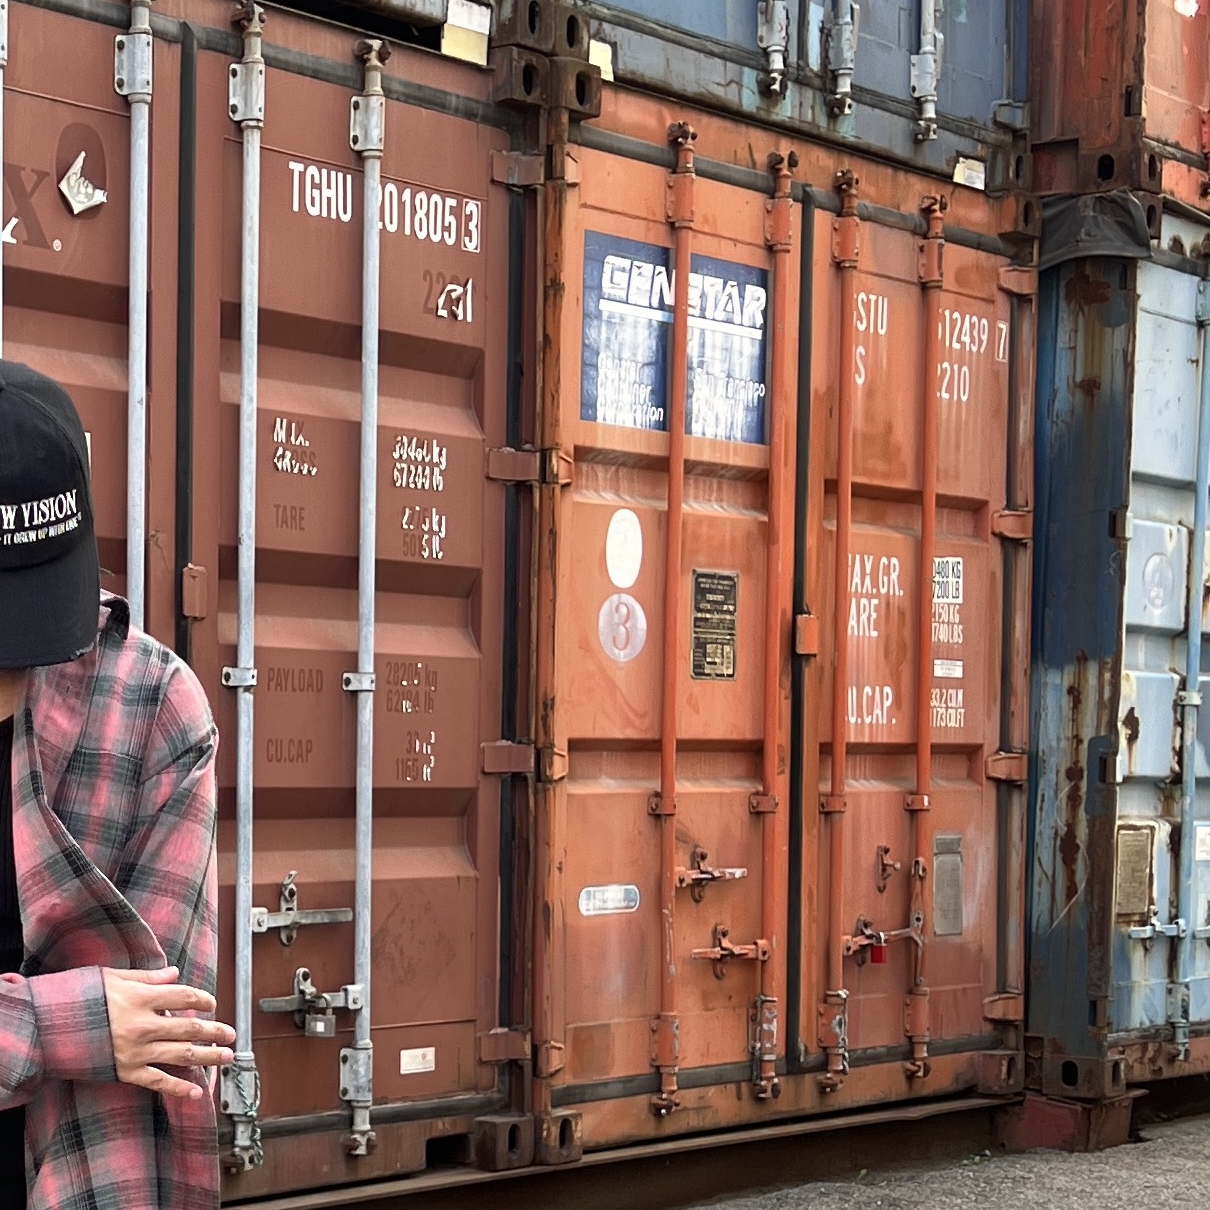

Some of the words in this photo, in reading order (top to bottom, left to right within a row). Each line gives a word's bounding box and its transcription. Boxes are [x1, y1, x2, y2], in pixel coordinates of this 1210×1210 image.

[288, 160, 352, 223] TGHU
[464, 200, 479, 250] 3
[602, 254, 767, 328] GENSTAR
[853, 290, 888, 336] STU
[937, 308, 989, 354] 12439
[852, 343, 866, 386] S
[21, 489, 77, 526] VISION
[273, 503, 306, 531] TARE
[611, 601, 631, 652] 3
[848, 597, 879, 637] ARE
[266, 667, 325, 694] PAYLOAD
[845, 685, 896, 725] U.CAP.
[266, 738, 314, 764] CU.CAP
